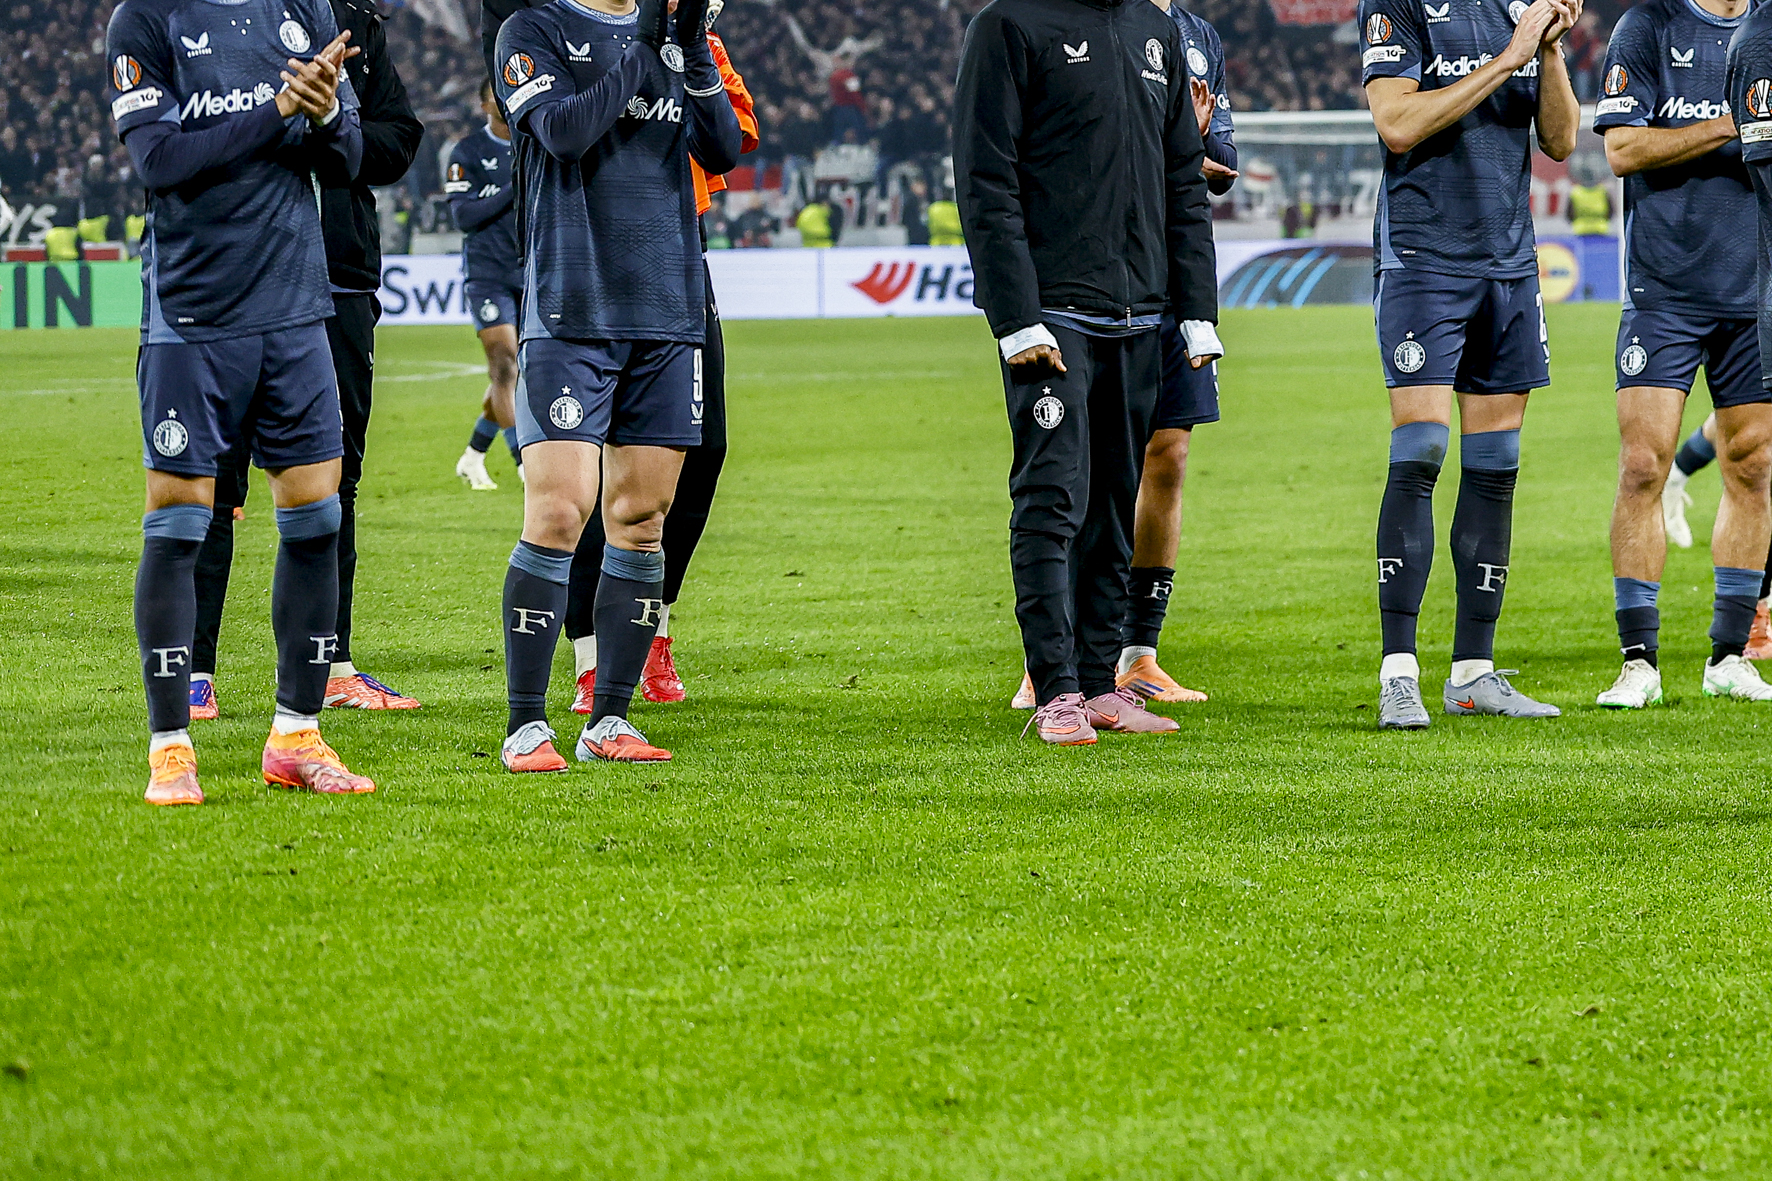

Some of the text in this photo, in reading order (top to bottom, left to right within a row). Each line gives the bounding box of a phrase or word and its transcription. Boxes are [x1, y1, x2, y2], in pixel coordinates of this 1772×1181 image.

[181, 87, 254, 122] Media
[1658, 96, 1721, 120] Media
[1377, 557, 1404, 584] F
[1476, 562, 1509, 593] F
[511, 606, 555, 636] F
[152, 645, 190, 678] F
[308, 633, 340, 665] F
